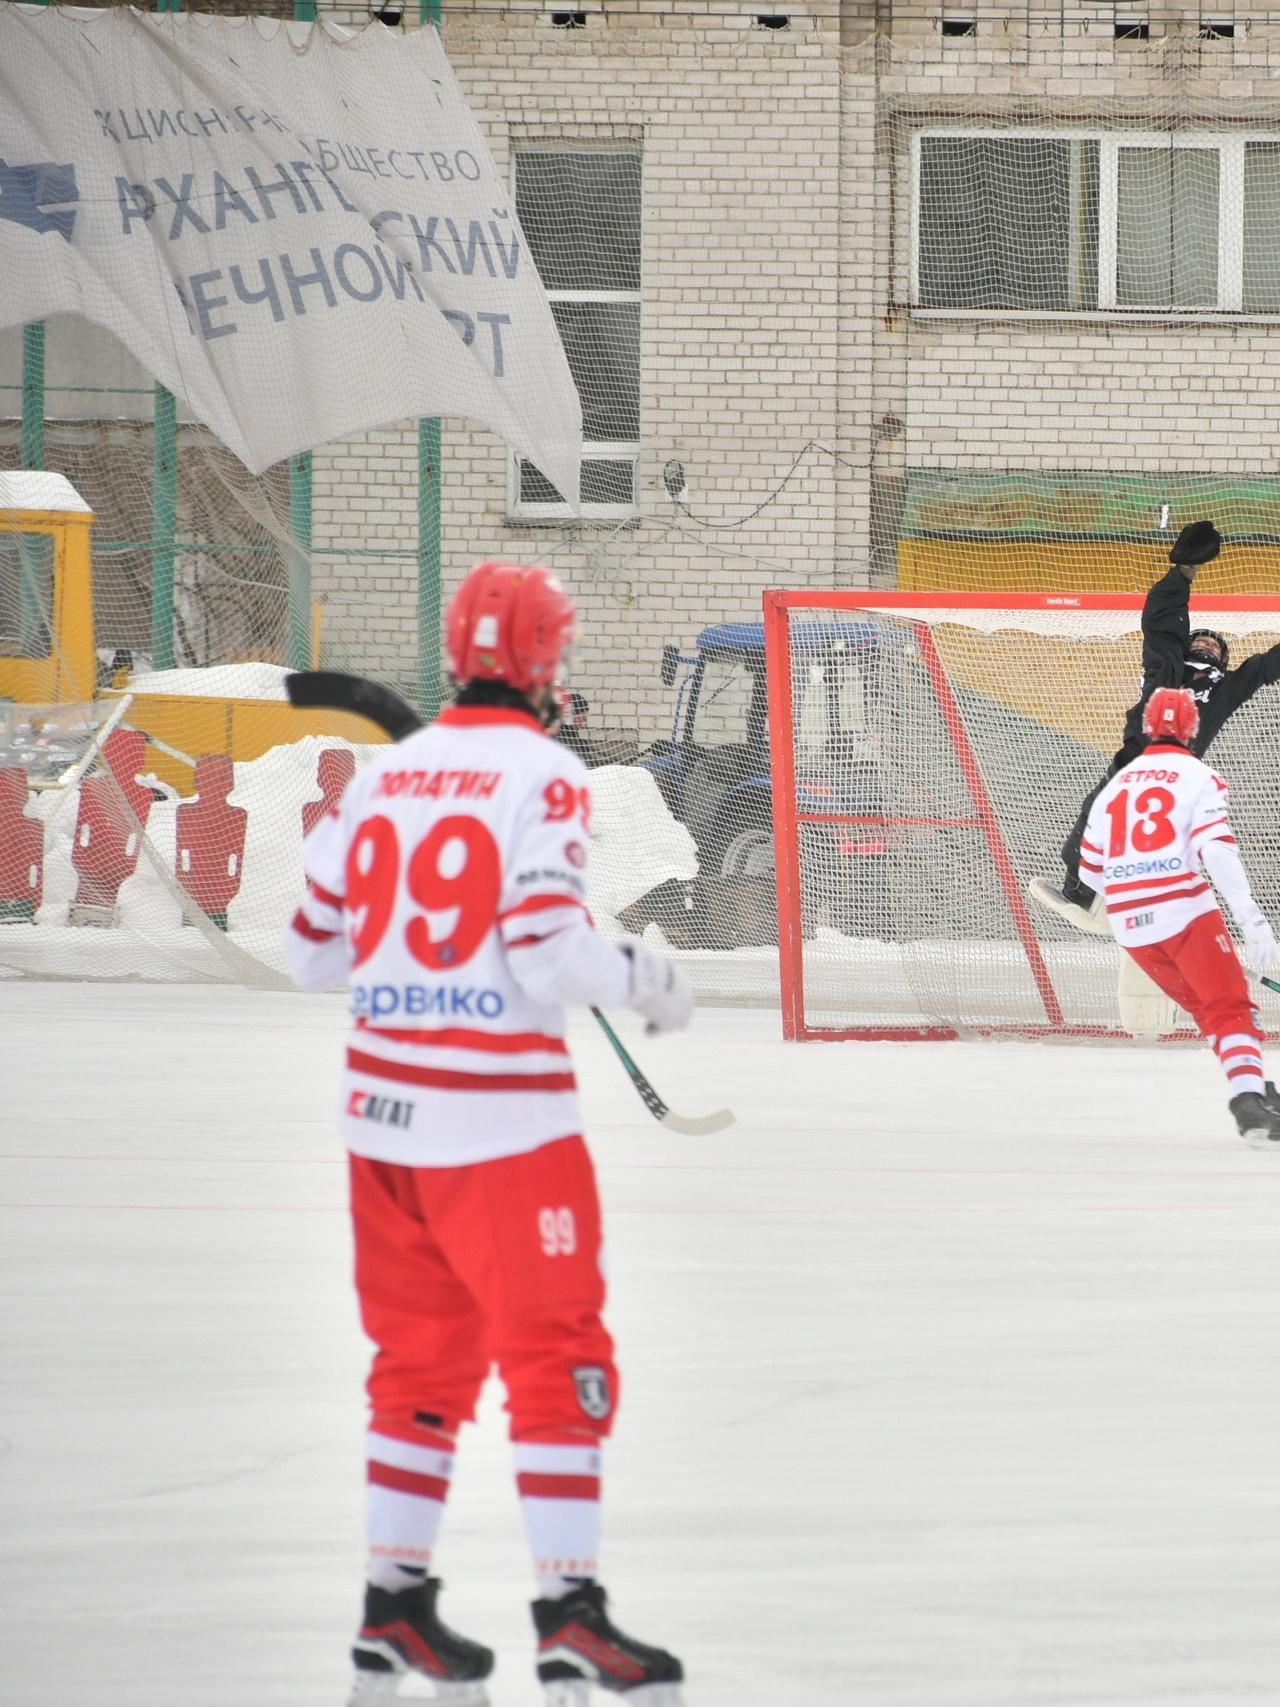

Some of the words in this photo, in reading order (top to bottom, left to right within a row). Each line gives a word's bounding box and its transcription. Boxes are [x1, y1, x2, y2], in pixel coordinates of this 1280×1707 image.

[299, 139, 481, 181] БЩЕСТВО
[1105, 786, 1176, 858] 13
[346, 814, 504, 972] 99
[539, 1207, 577, 1256] 99
